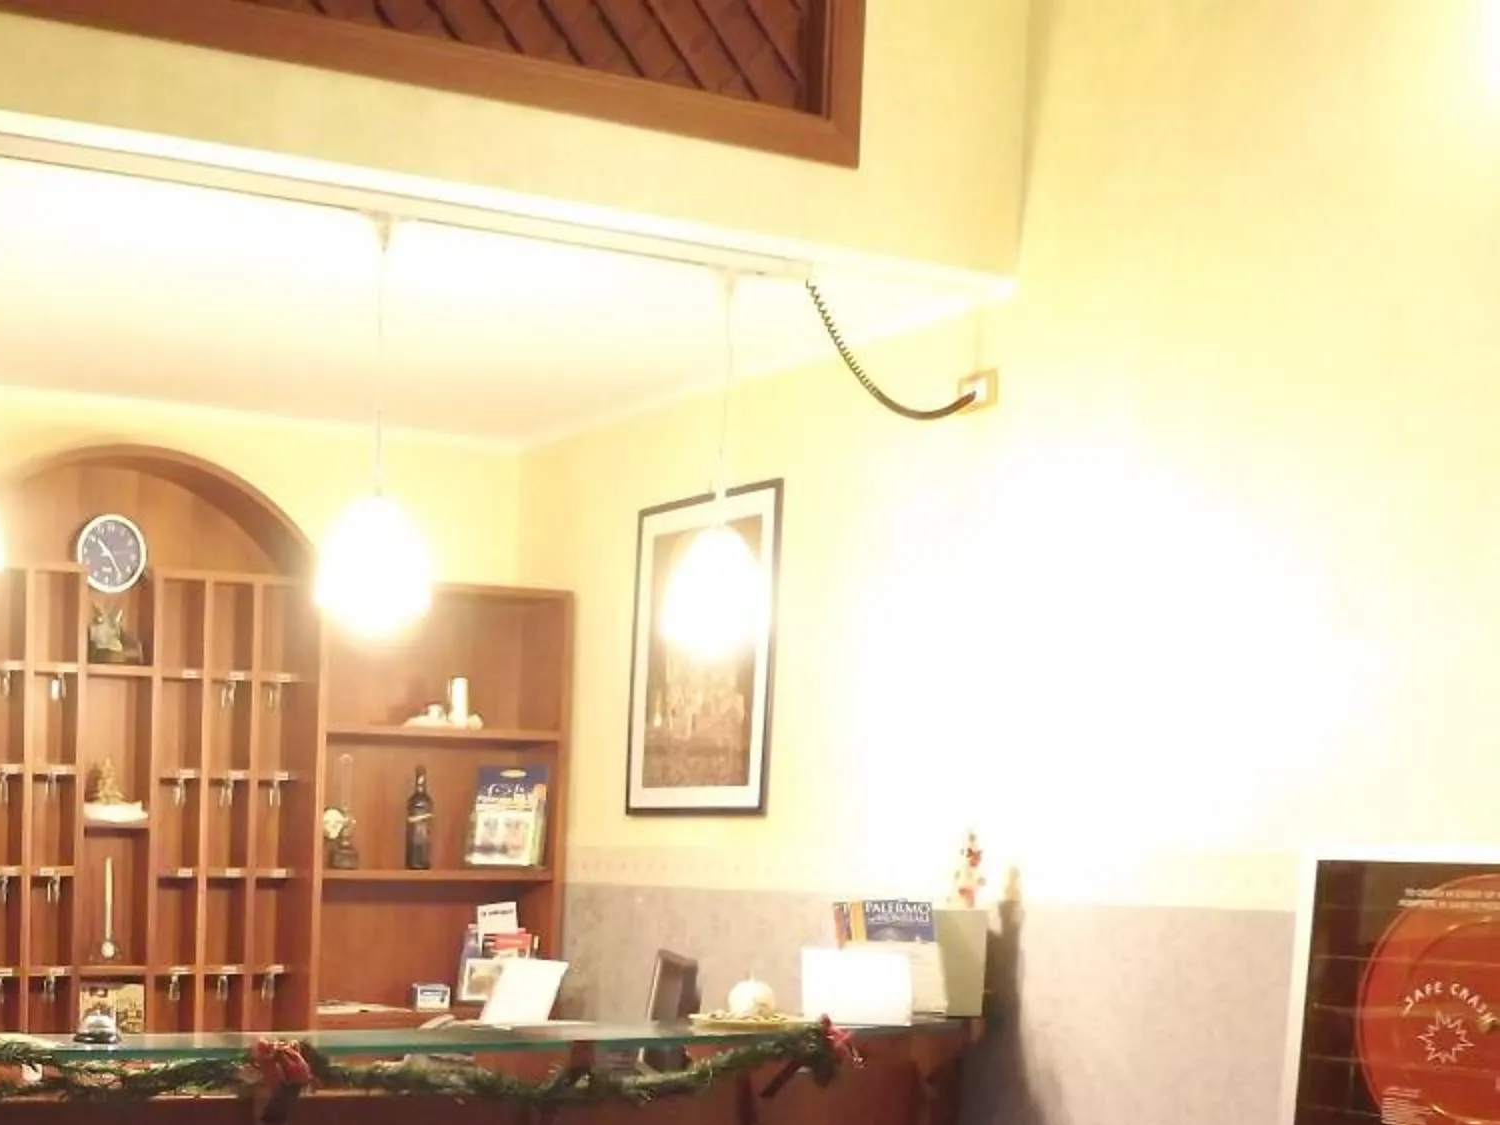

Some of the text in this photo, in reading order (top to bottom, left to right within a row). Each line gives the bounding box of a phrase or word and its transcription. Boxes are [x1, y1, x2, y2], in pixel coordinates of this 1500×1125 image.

[865, 902, 931, 914] PALERMO
[1402, 981, 1498, 1026] SAFE CRASH
